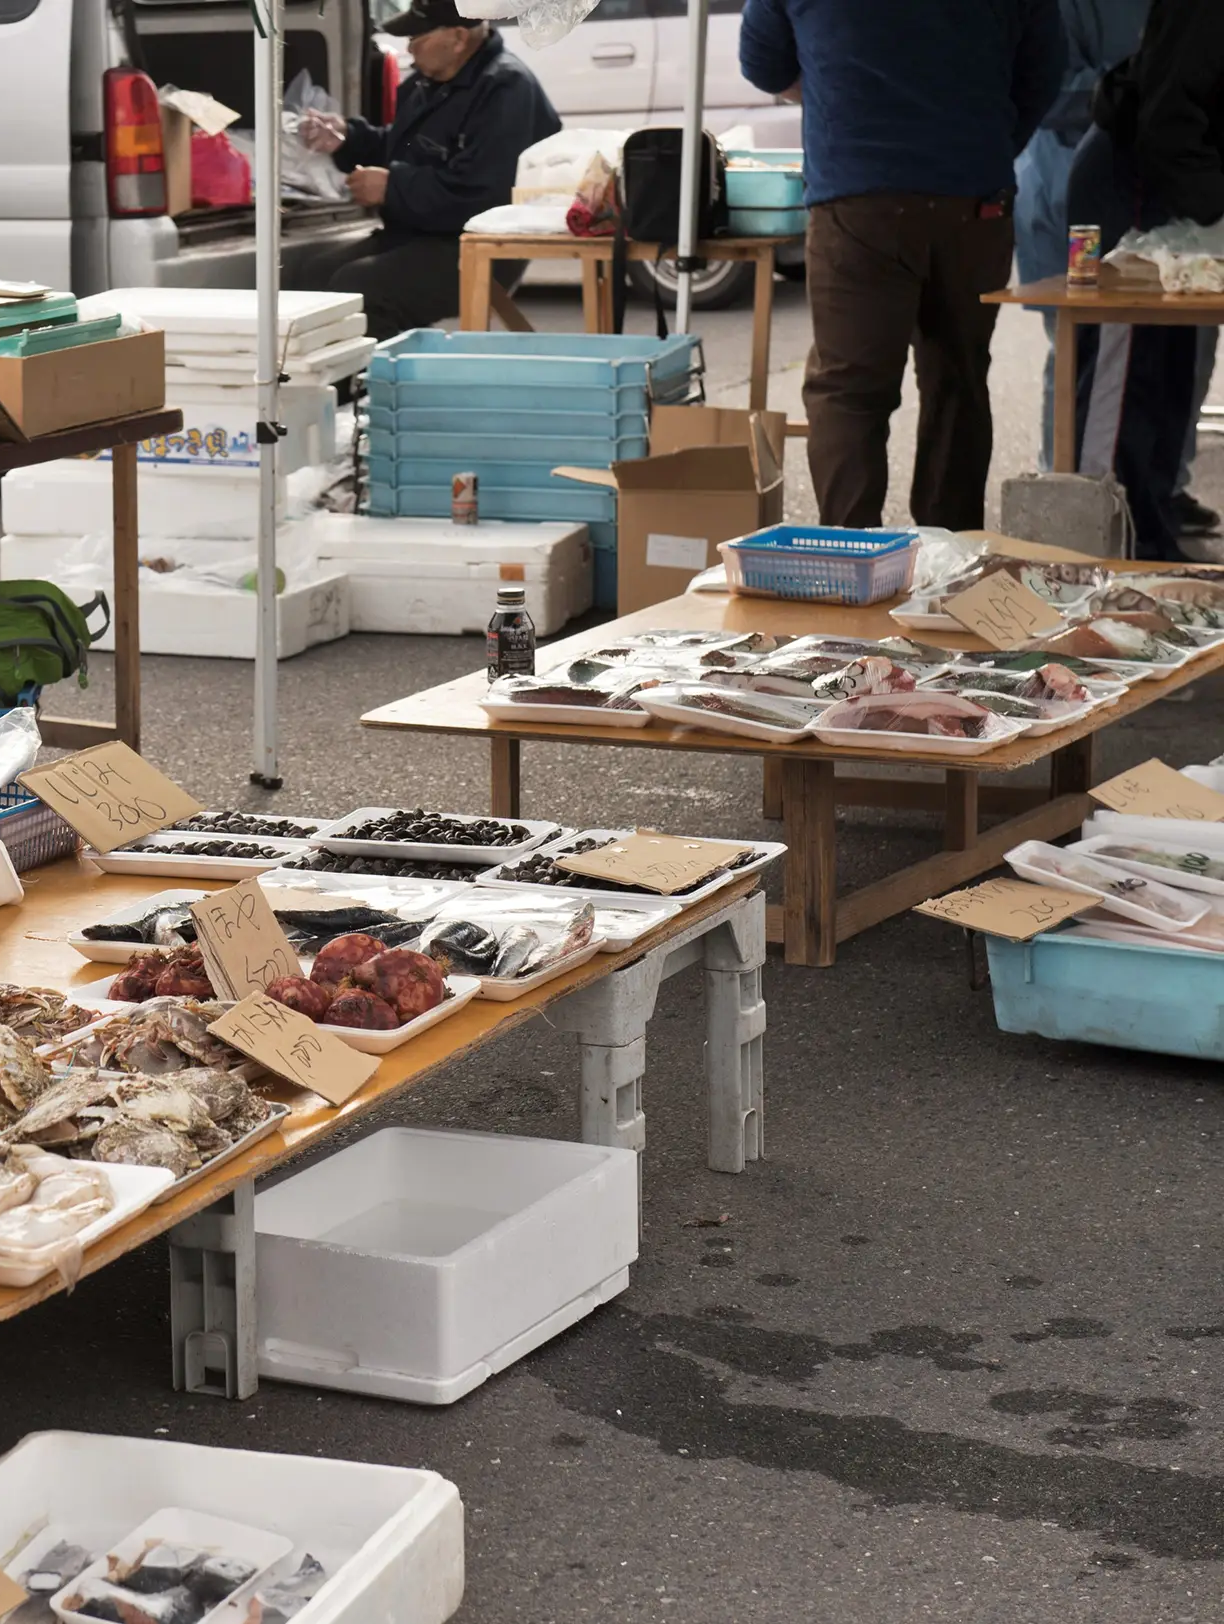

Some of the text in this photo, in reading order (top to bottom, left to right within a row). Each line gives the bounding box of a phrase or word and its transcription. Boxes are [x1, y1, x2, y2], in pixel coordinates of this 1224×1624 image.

[45, 759, 132, 805] しじみ
[96, 796, 167, 831] 300
[205, 889, 260, 944] ほや
